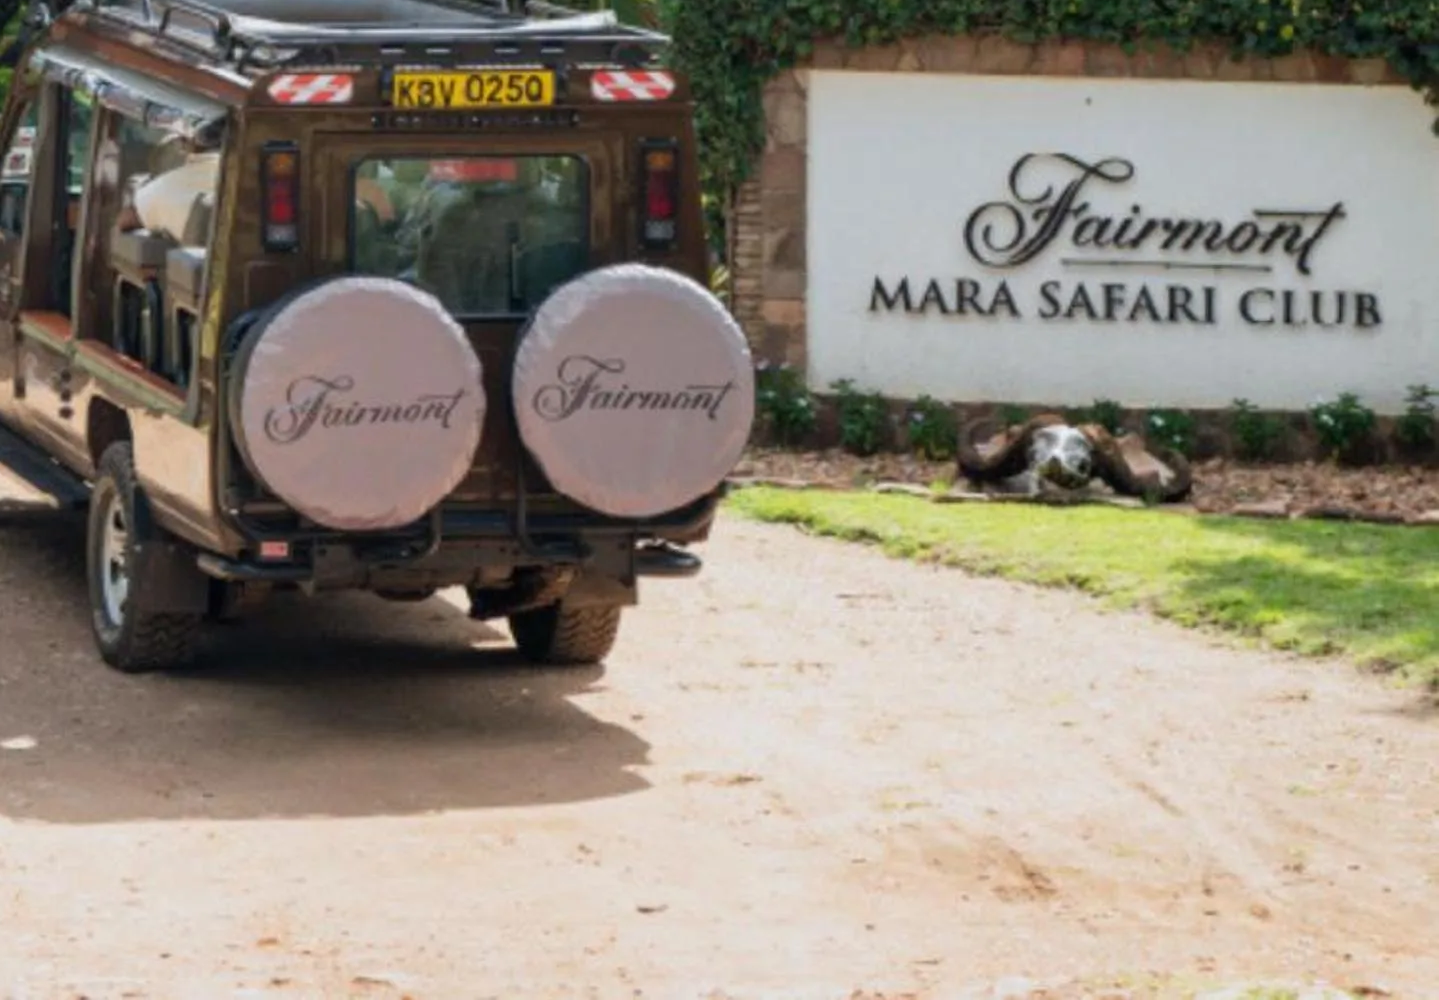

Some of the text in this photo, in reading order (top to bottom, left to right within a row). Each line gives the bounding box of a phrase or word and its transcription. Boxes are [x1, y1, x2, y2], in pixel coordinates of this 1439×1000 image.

[963, 152, 1347, 276] Fairmont
[869, 274, 1383, 328] MARA SAFARI CLUB
[264, 374, 468, 445] Fairmont
[533, 354, 738, 422] Fairmont
